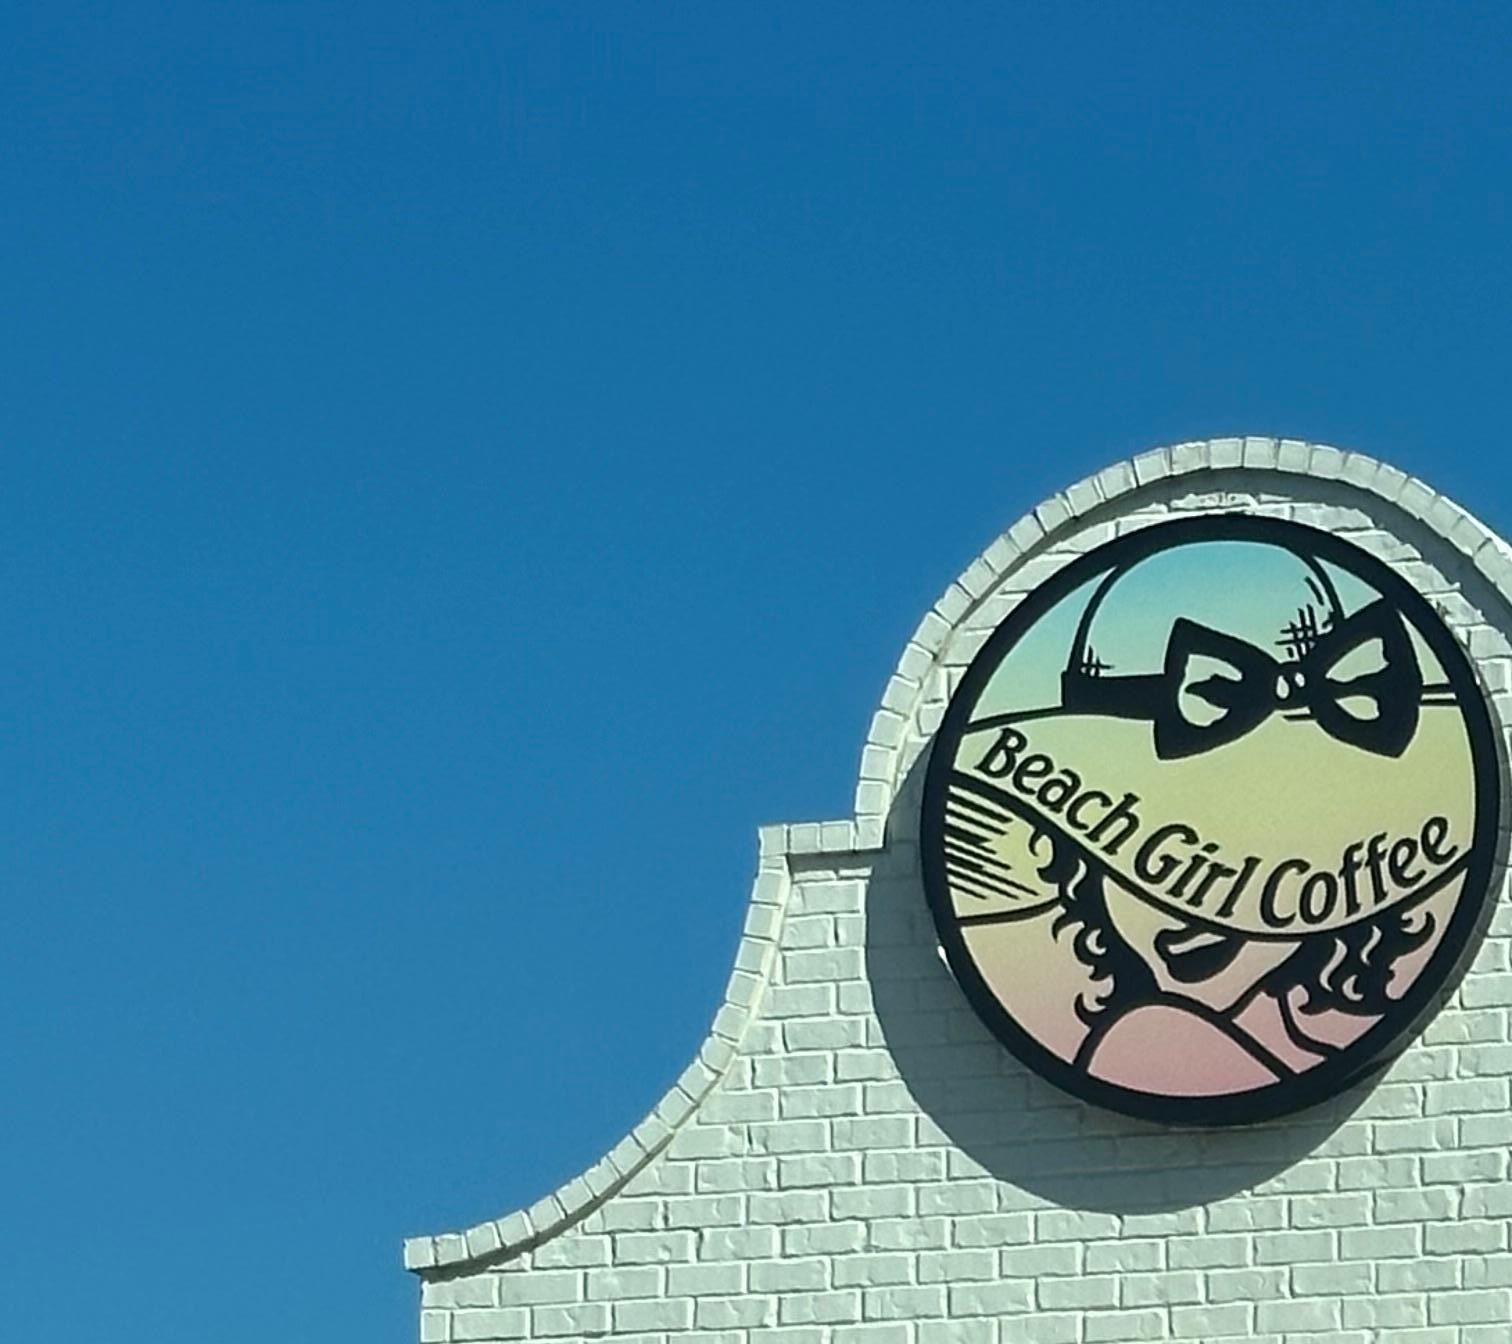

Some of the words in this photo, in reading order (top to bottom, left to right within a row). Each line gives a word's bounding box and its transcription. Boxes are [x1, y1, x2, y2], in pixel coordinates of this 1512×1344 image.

[974, 726, 1143, 856] Beach
[1134, 823, 1260, 919] Girl
[1259, 815, 1459, 928] Coffee
